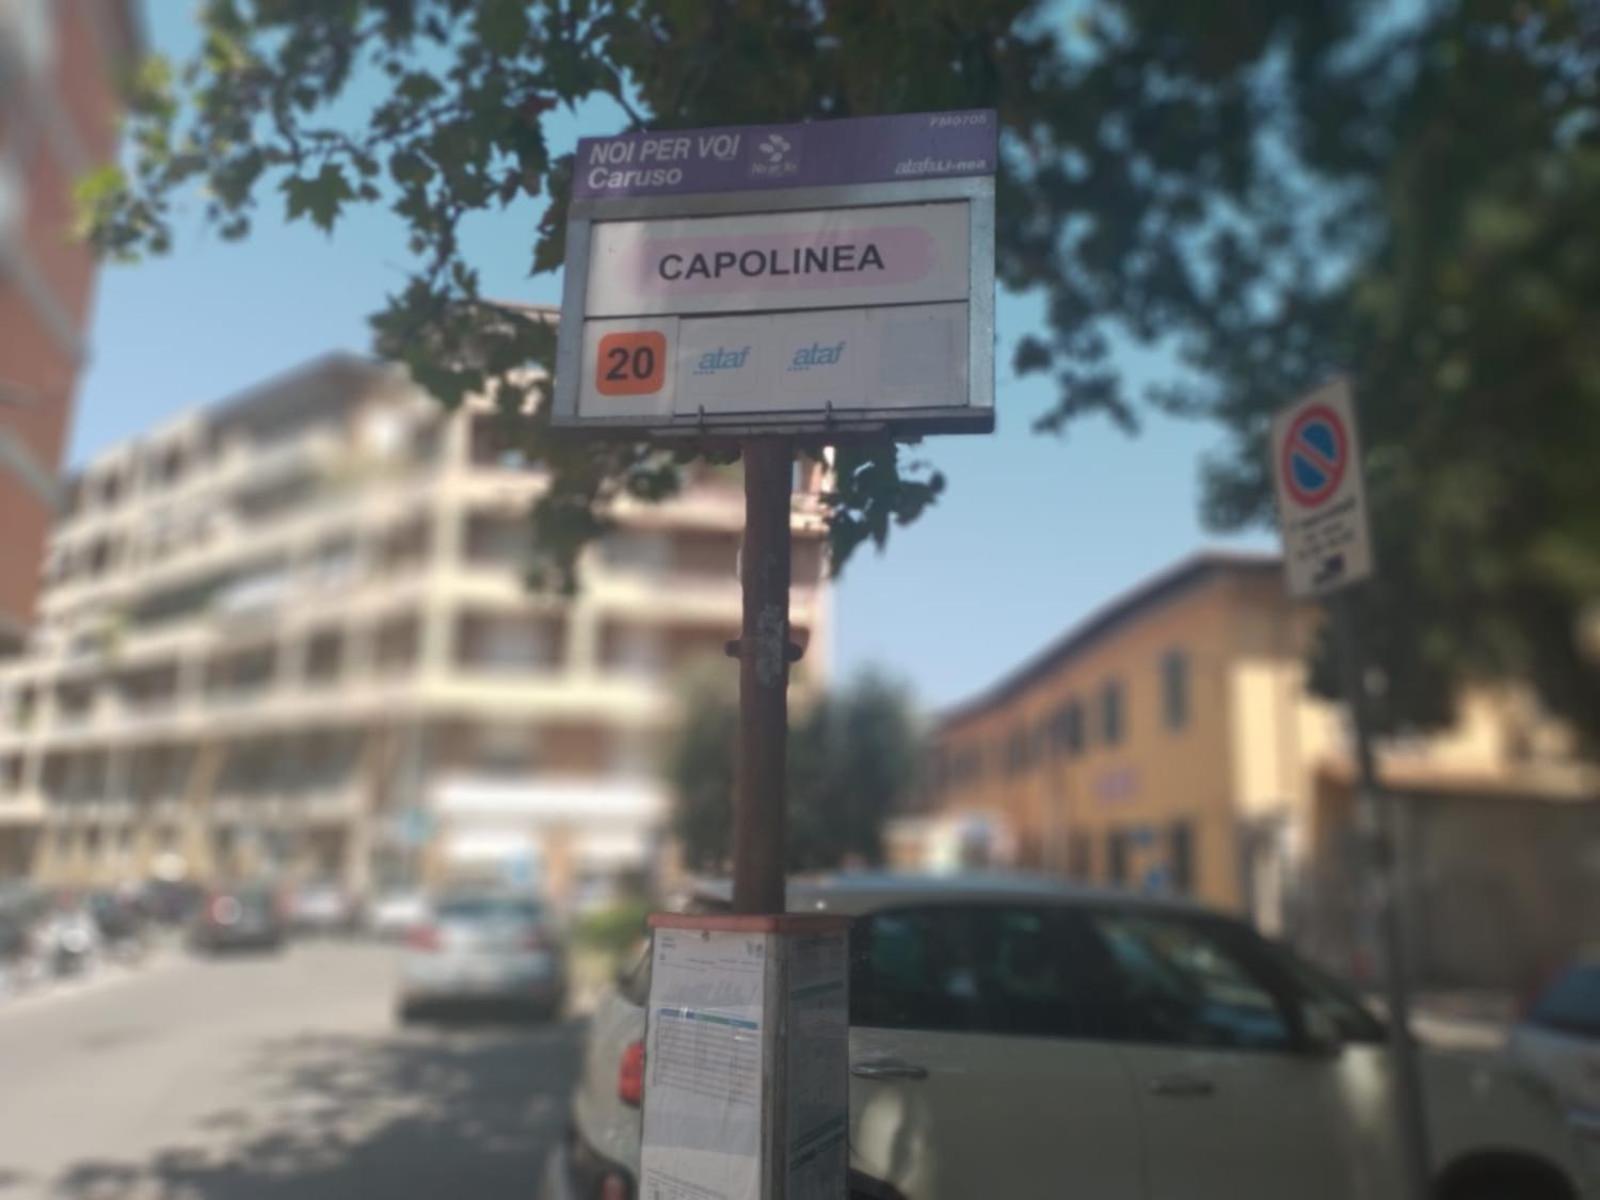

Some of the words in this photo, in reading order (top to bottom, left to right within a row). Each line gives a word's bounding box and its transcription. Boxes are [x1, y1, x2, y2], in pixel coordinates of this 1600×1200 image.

[589, 141, 636, 165] NOI
[640, 137, 692, 161] PER
[699, 134, 741, 158] VOI
[588, 168, 683, 189] Caruso
[658, 243, 885, 281] CAPOLINEA
[605, 346, 655, 381] 20
[698, 347, 751, 370] ataf
[792, 342, 846, 366] ataf
